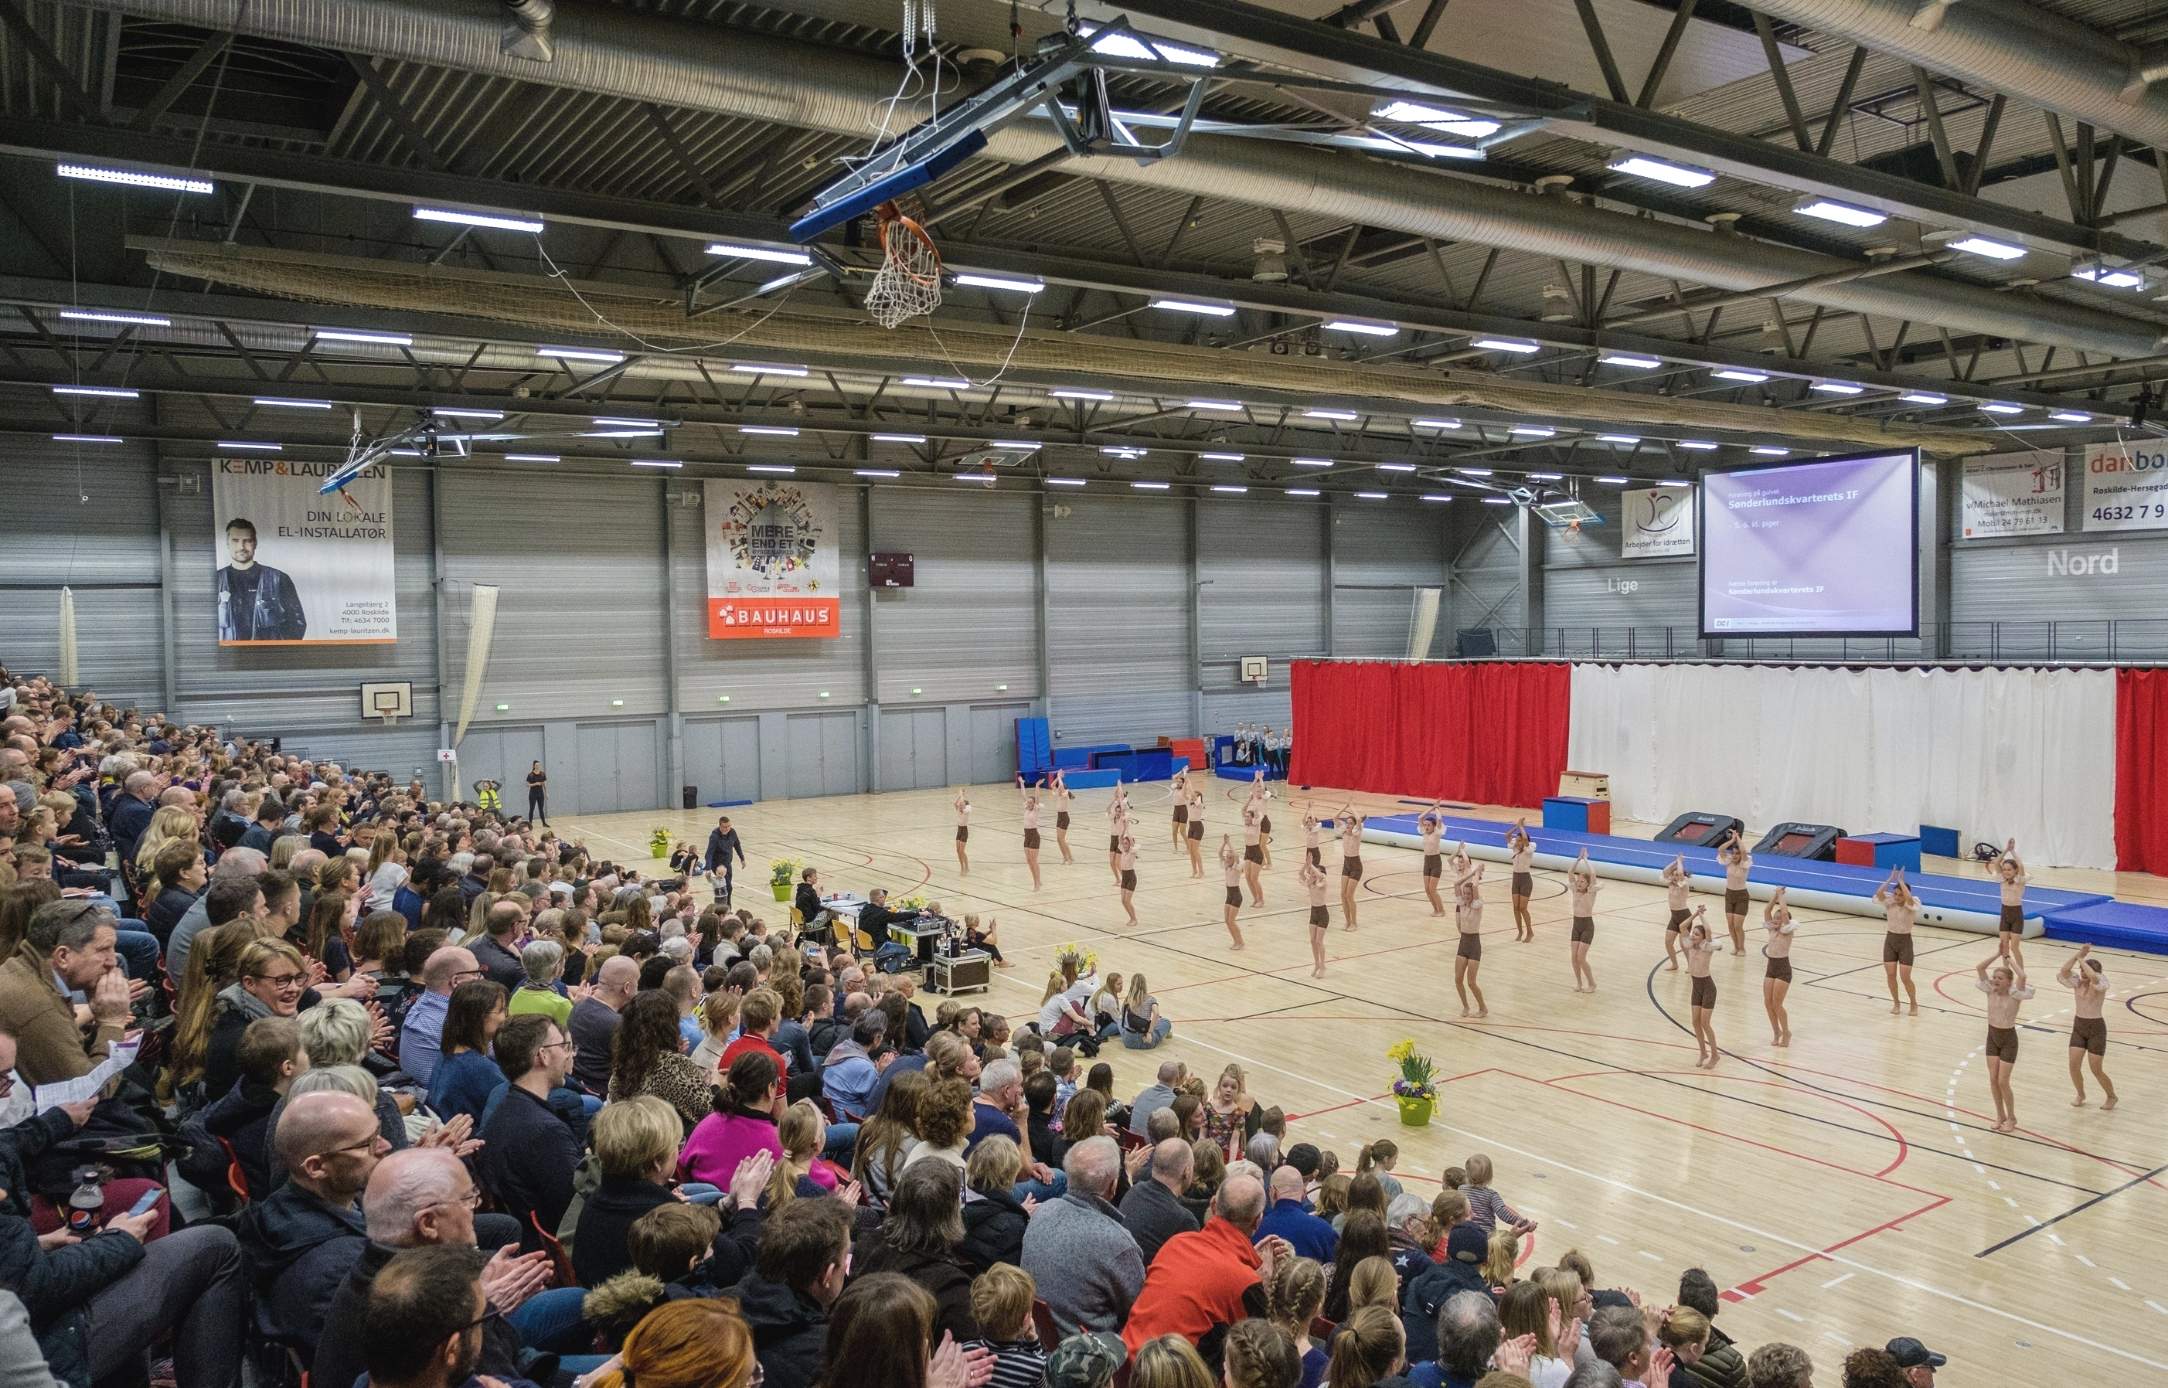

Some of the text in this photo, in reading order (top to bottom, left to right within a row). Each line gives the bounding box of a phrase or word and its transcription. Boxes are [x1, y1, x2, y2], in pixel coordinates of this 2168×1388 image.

[2091, 450, 2168, 473] danbo
[1846, 490, 1859, 500] IF
[307, 511, 386, 523] DIN LOKALE
[2092, 504, 2165, 520] 4632 7 9
[278, 526, 386, 539] EL-INSTALLATØR
[752, 525, 793, 538] MERE
[752, 539, 794, 549] END ET
[2047, 548, 2119, 577] Nord
[1607, 578, 1639, 595] Lige
[738, 609, 829, 623] BAUHAUS
